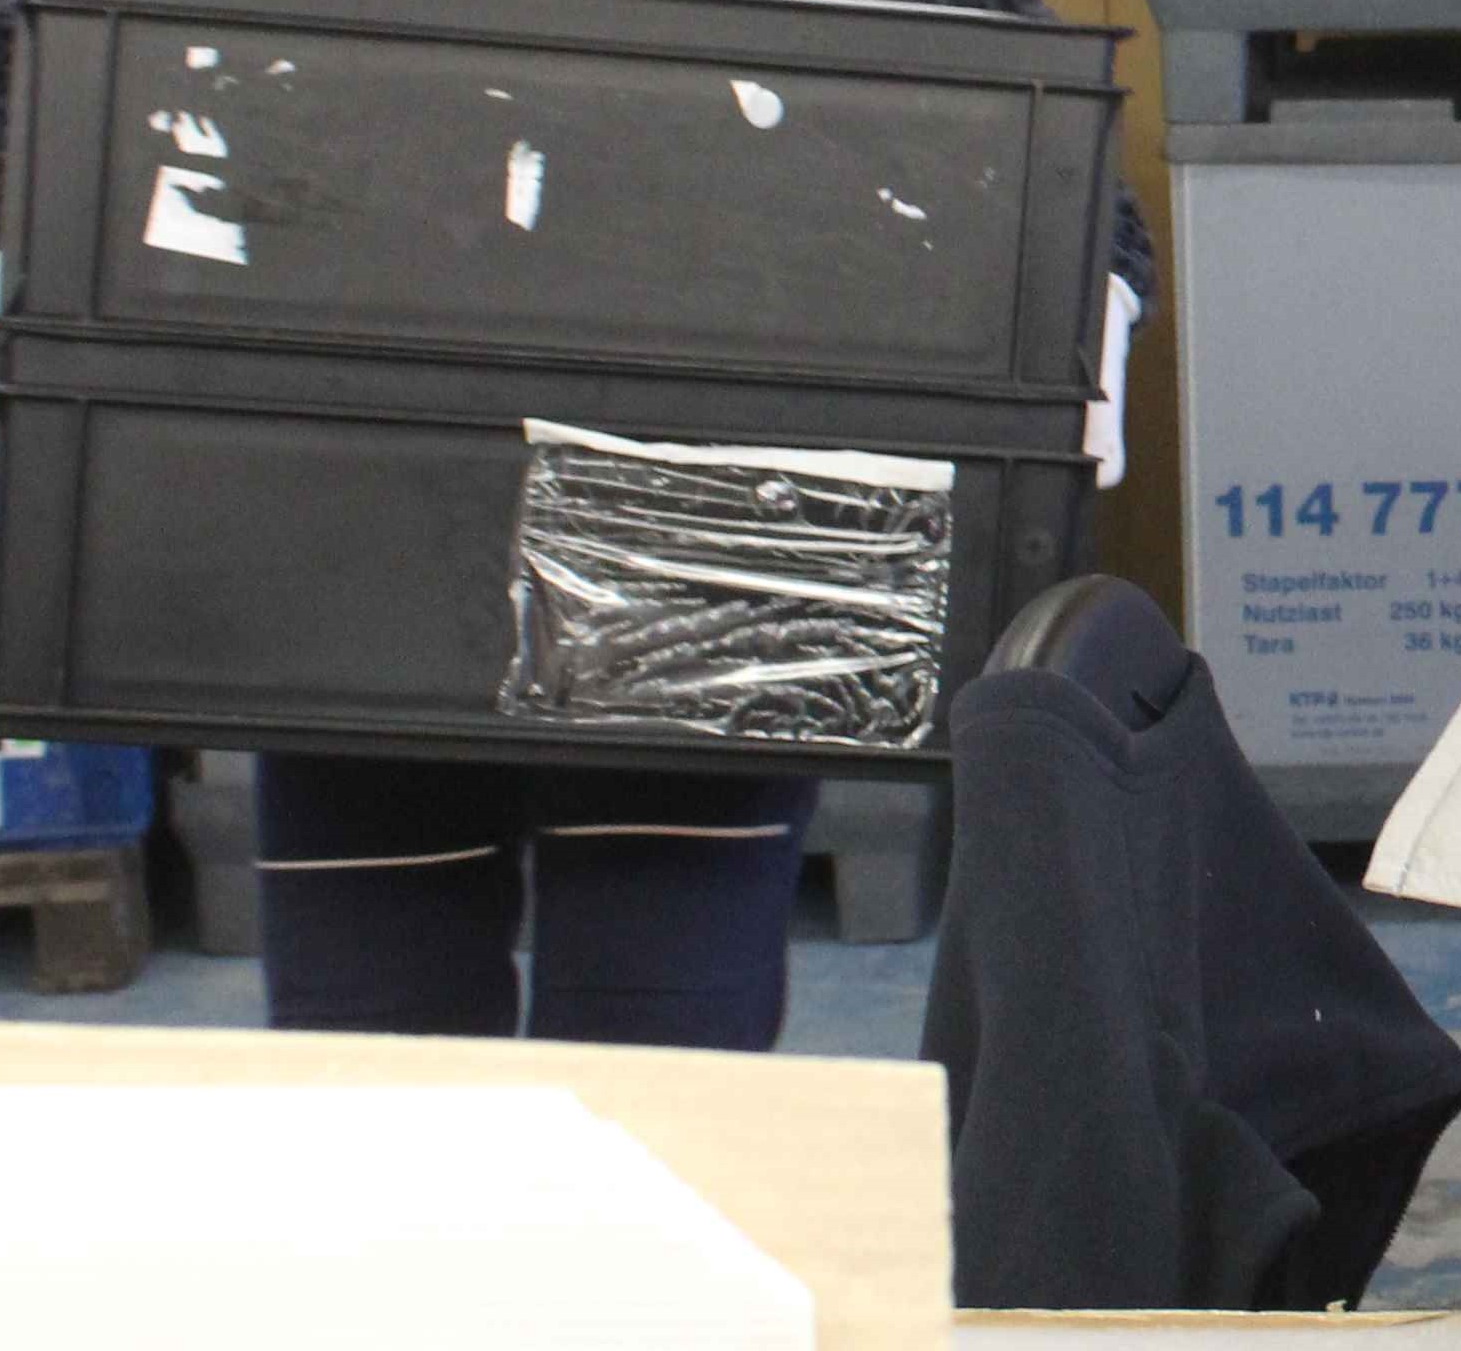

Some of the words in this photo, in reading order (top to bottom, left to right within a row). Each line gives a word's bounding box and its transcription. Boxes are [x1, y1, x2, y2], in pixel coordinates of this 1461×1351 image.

[1214, 483, 1340, 538] 114
[1242, 572, 1388, 596] Stapelfaktor
[1242, 603, 1342, 623] Nutzlast
[1390, 602, 1433, 622] 250
[1243, 634, 1295, 654] Tara
[1404, 632, 1432, 652] 36
